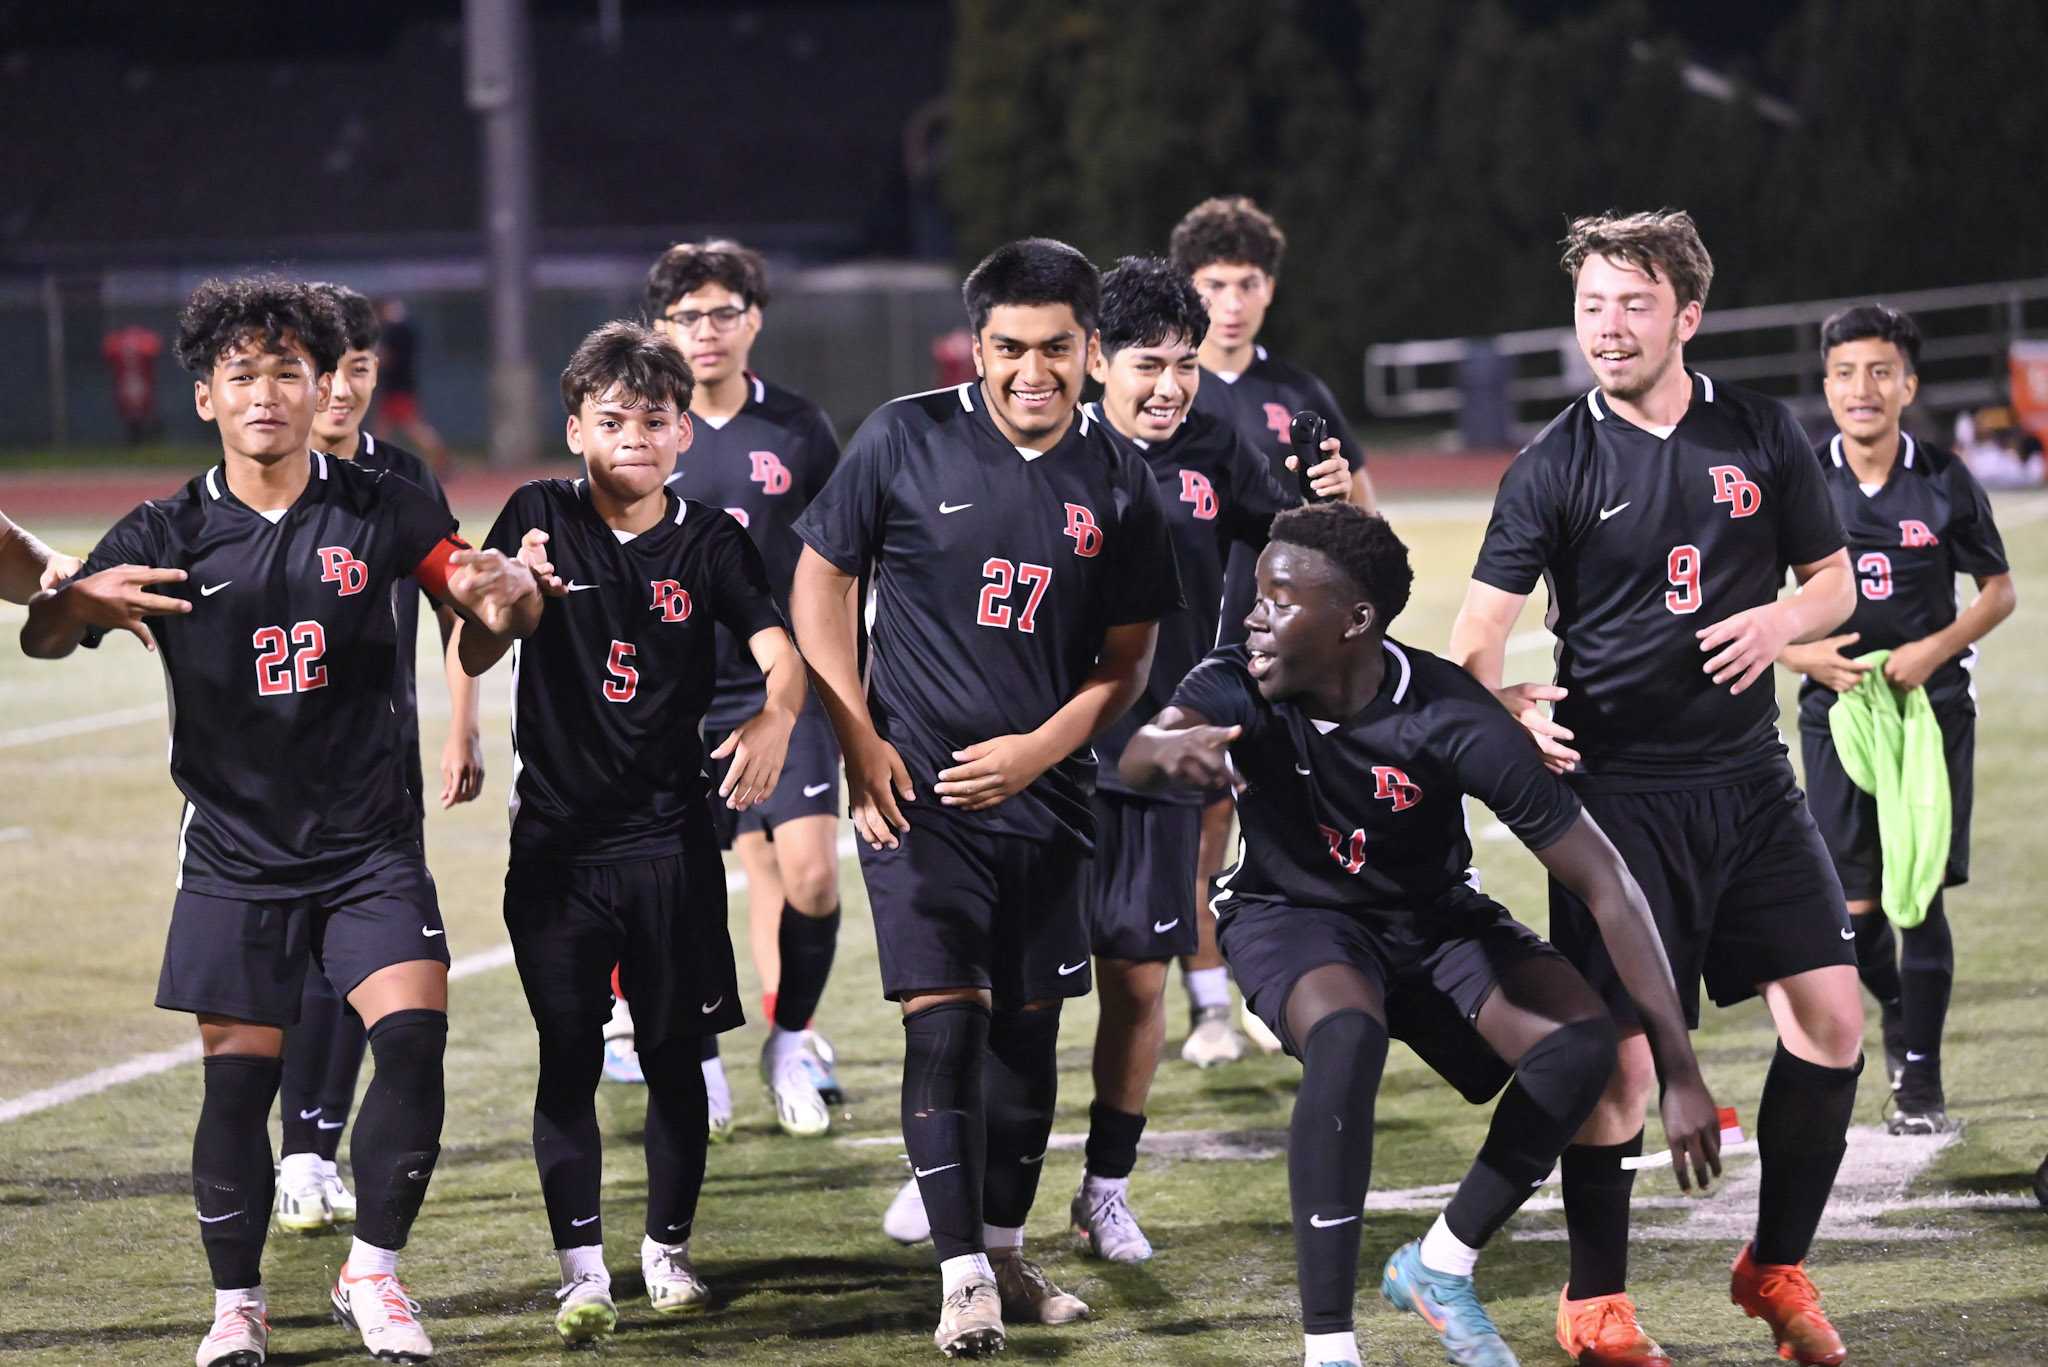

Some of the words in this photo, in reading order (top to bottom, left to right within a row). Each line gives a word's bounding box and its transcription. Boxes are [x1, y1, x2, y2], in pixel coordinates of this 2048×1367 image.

[1709, 465, 1761, 518] DD
[1064, 502, 1103, 557] DD
[317, 546, 368, 596] DD
[977, 557, 1052, 633] 27
[1665, 544, 1702, 614] 9
[1857, 552, 1893, 600] 3
[649, 579, 692, 622] DD
[253, 620, 328, 696] 22
[603, 640, 639, 702] 5
[1371, 766, 1423, 812] DD
